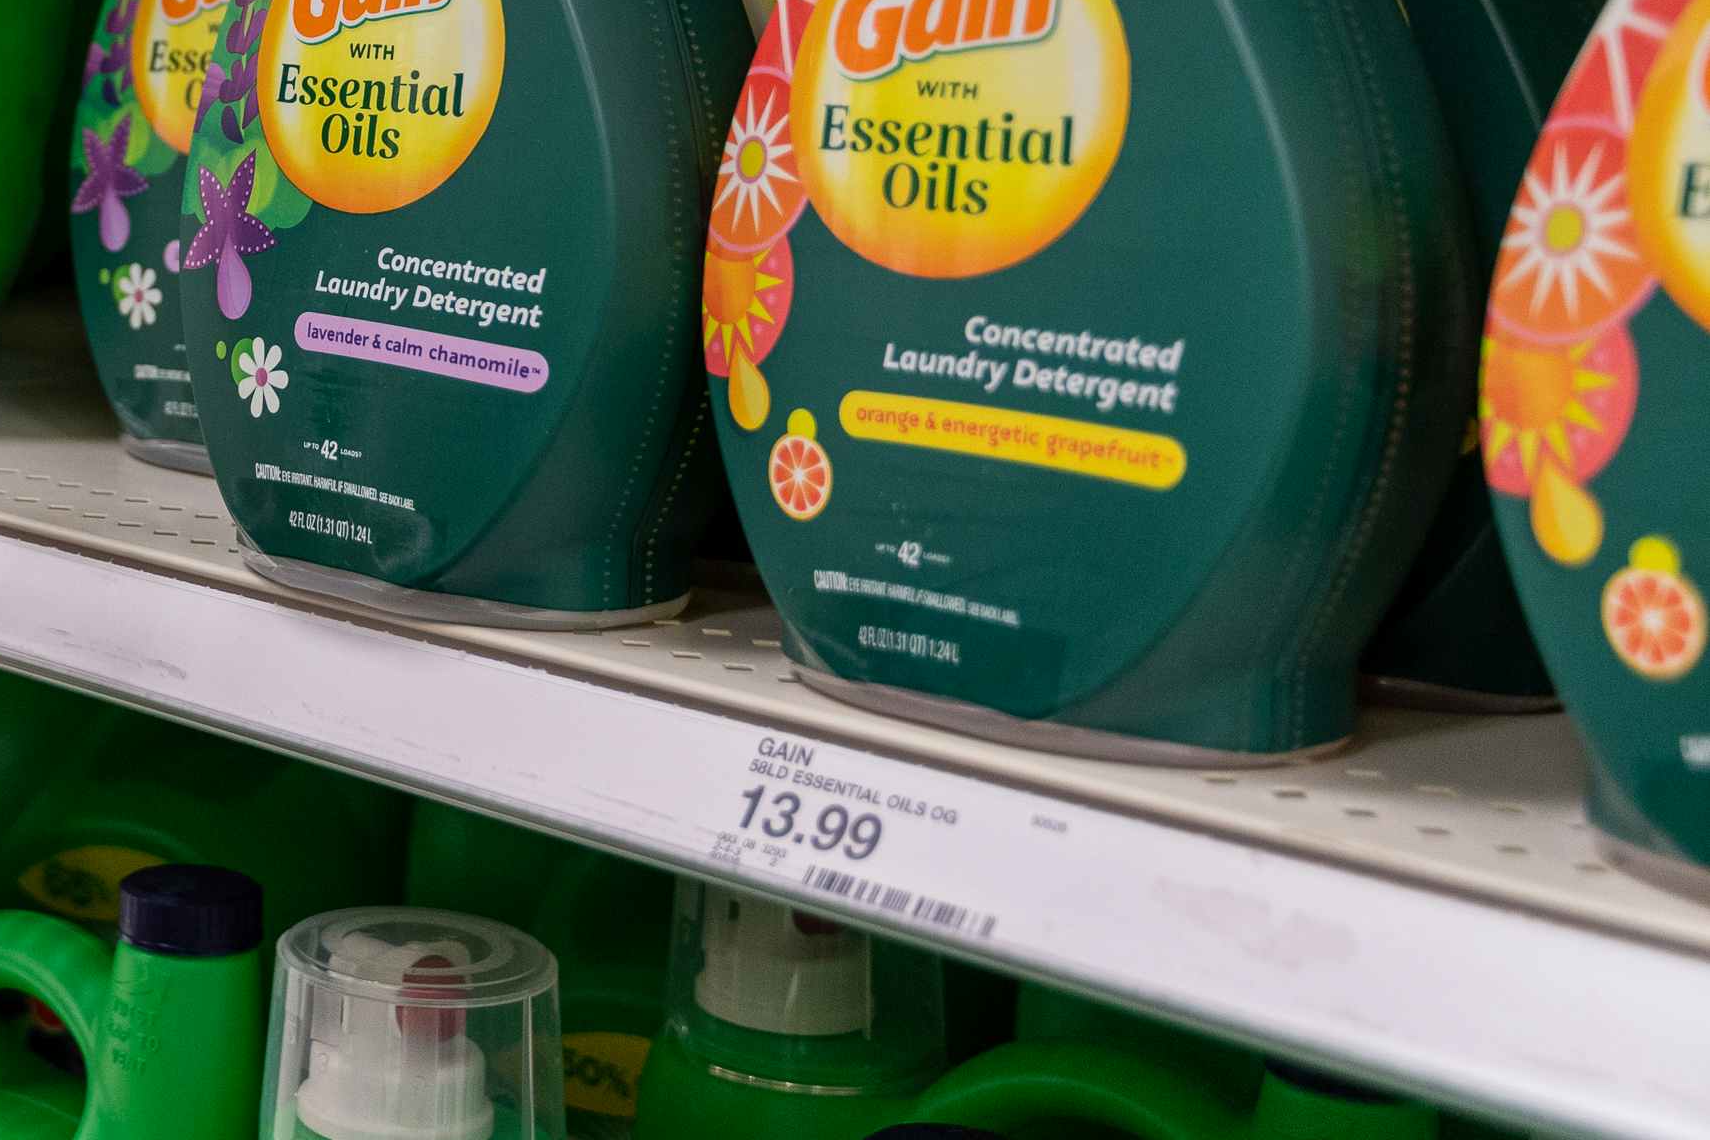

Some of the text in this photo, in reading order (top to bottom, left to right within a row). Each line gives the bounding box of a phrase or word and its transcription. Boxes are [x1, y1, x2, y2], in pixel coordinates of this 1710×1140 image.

[349, 43, 395, 61] WITH
[277, 63, 465, 117] Essential
[917, 79, 978, 100] WITH
[322, 112, 400, 159] Oils
[818, 103, 1075, 167] Essential
[882, 162, 989, 216] Oils
[377, 247, 546, 294] Concentrated
[314, 270, 542, 328] Laundry Detergent
[307, 322, 369, 347] lavender
[372, 334, 381, 349] &
[385, 337, 423, 357] calm
[964, 315, 1185, 373] Concentrated
[883, 343, 1178, 413] Laundry Detergent
[321, 439, 338, 460] 42
[856, 406, 920, 433] orange
[925, 412, 937, 430] &
[942, 413, 1040, 447] energetic
[255, 462, 281, 481] CAUTION:
[289, 510, 297, 527] 42
[297, 512, 306, 529] FL
[306, 514, 316, 530] OZ
[316, 514, 334, 535] (1.31
[336, 519, 350, 541] QT)
[350, 523, 366, 543] 1.24
[898, 540, 922, 567] 42
[757, 736, 815, 767] GAIN
[748, 758, 957, 827] 58LD ESSENTIAL OILS OG
[738, 783, 882, 861] 13.99
